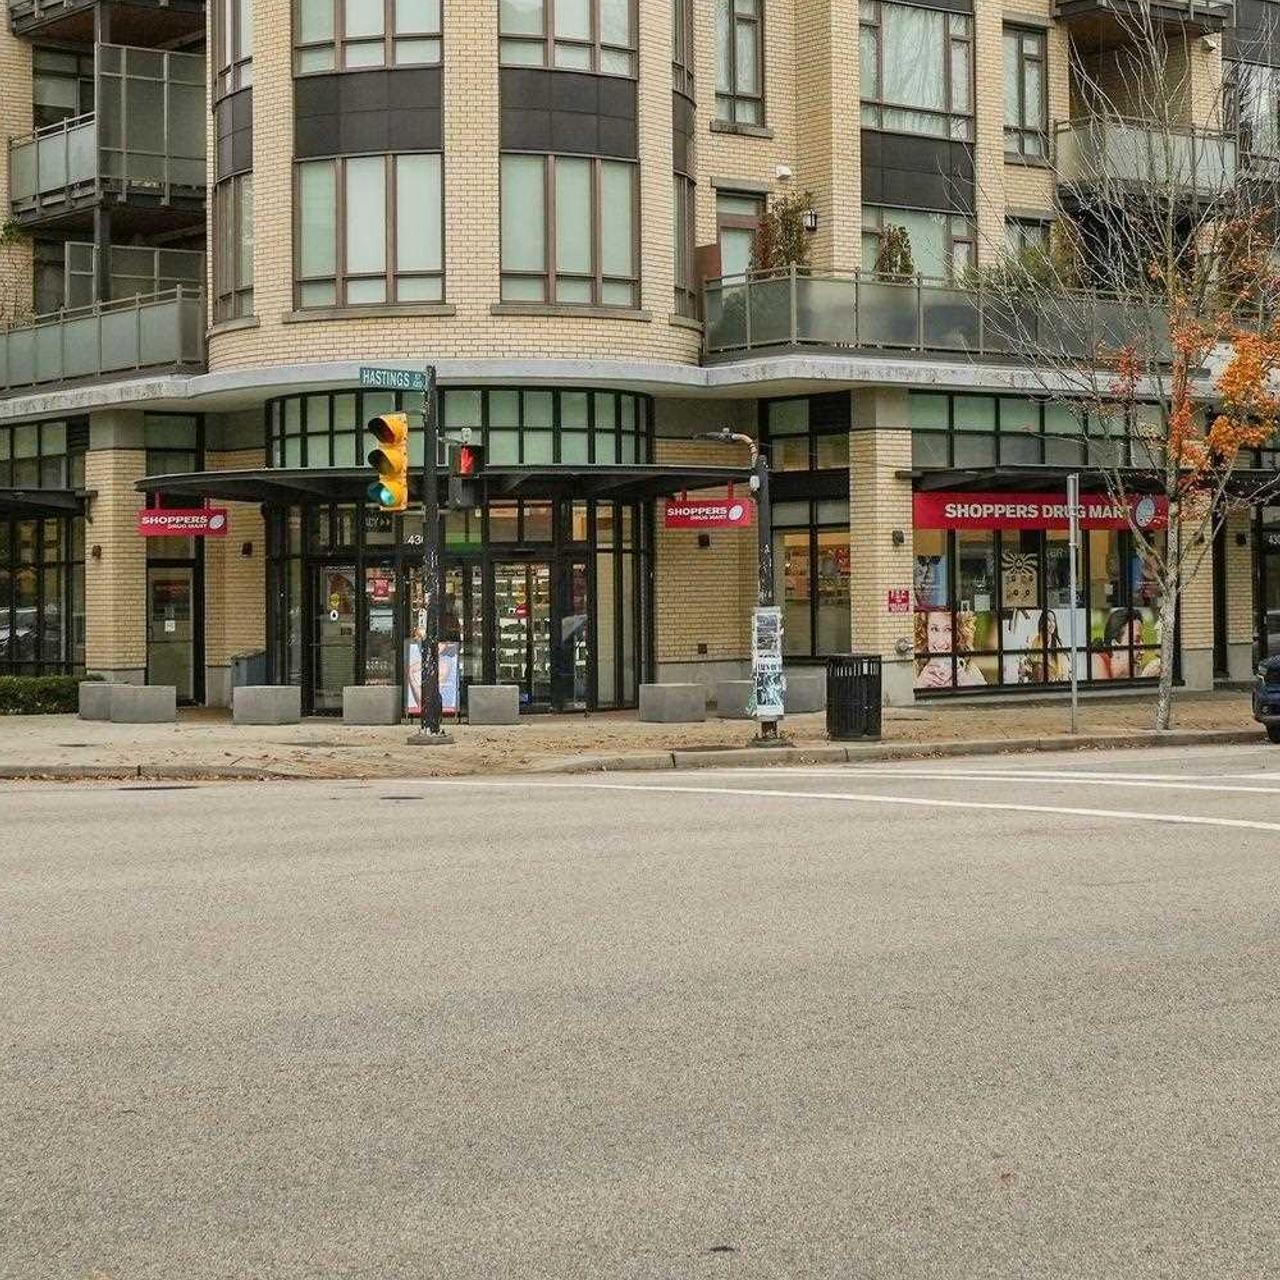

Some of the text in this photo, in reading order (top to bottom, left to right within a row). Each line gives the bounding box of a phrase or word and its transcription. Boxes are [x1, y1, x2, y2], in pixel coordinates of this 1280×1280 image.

[363, 369, 410, 388] HASTINGS
[667, 506, 728, 516] SHOPPERS
[944, 503, 1039, 519] SHOPPERS
[1088, 505, 1133, 519] MART
[141, 515, 208, 524] SHOPPERS
